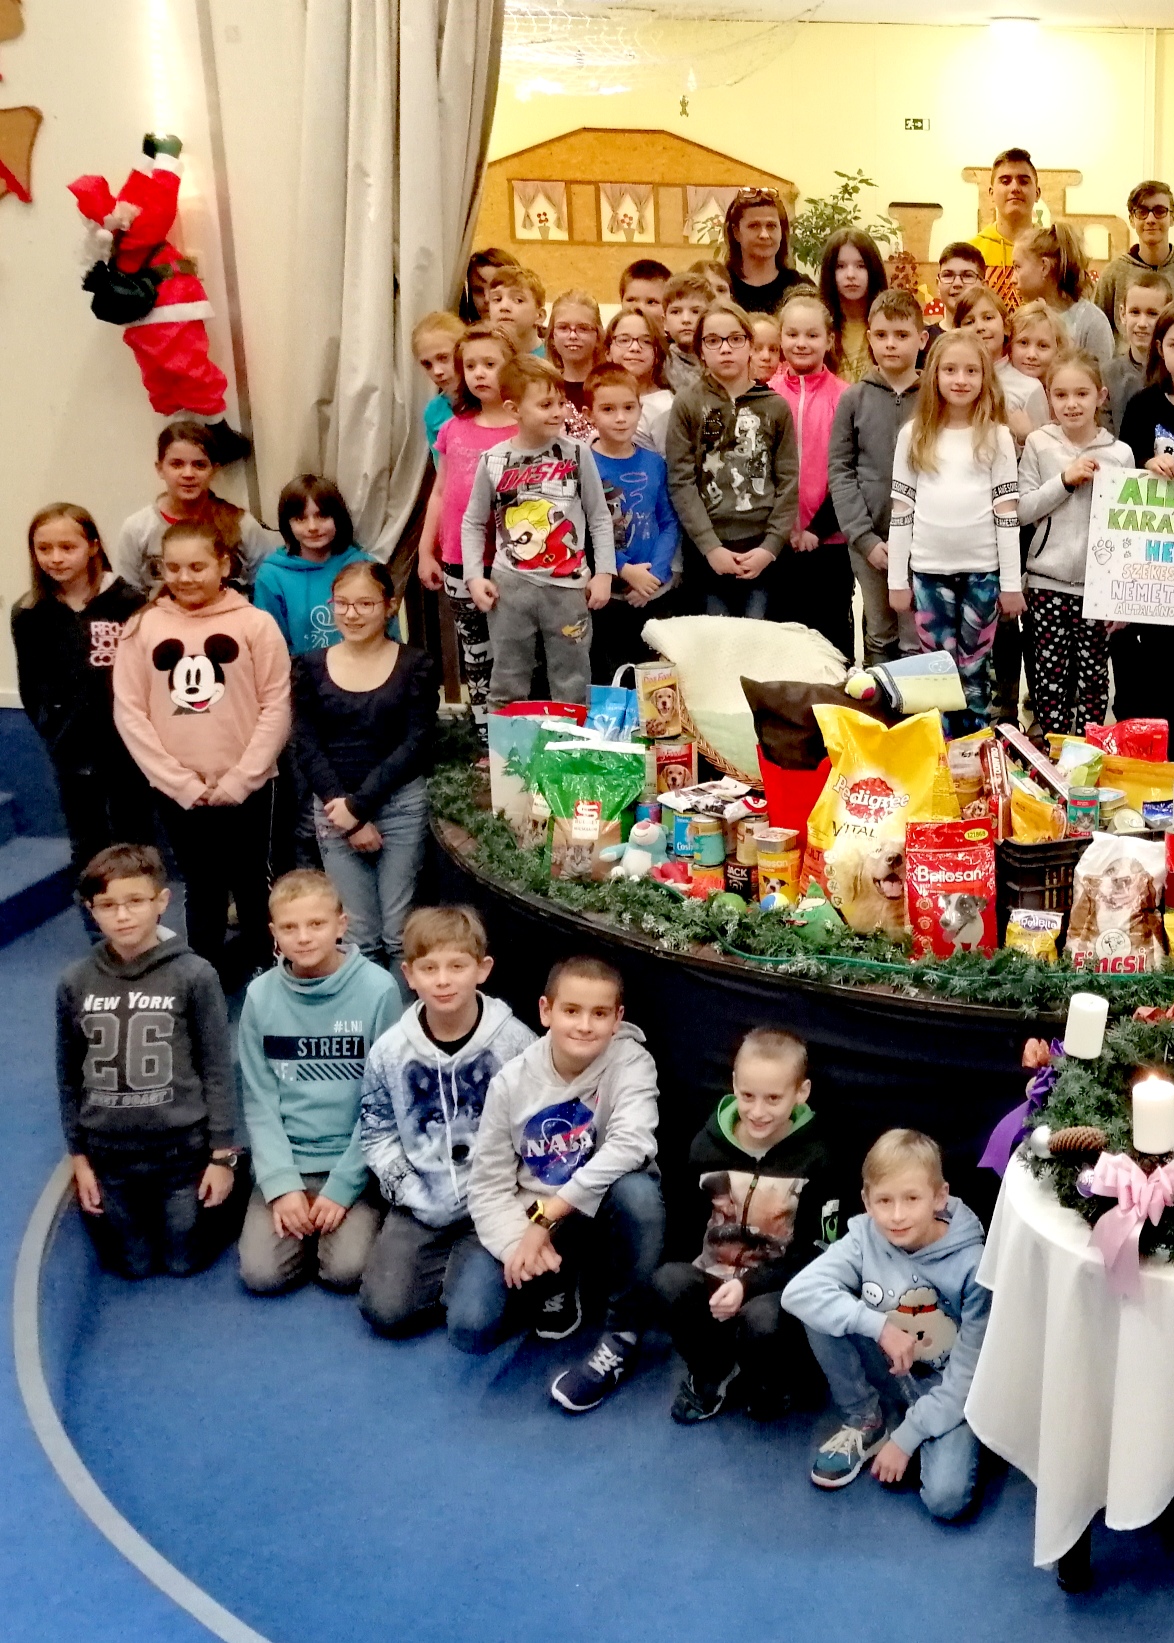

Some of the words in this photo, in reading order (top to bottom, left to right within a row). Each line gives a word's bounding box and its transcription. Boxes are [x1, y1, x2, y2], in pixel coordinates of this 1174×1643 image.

[496, 459, 578, 493] DASH
[91, 636, 119, 651] YOU
[832, 773, 910, 809] Pedigree
[727, 866, 748, 877] JACK
[916, 865, 983, 884] Bellosan
[82, 994, 121, 1012] NEW
[128, 991, 176, 1010] YORK
[81, 1011, 175, 1091] 26
[297, 1037, 360, 1057] STREET
[526, 1131, 594, 1158] NASA
